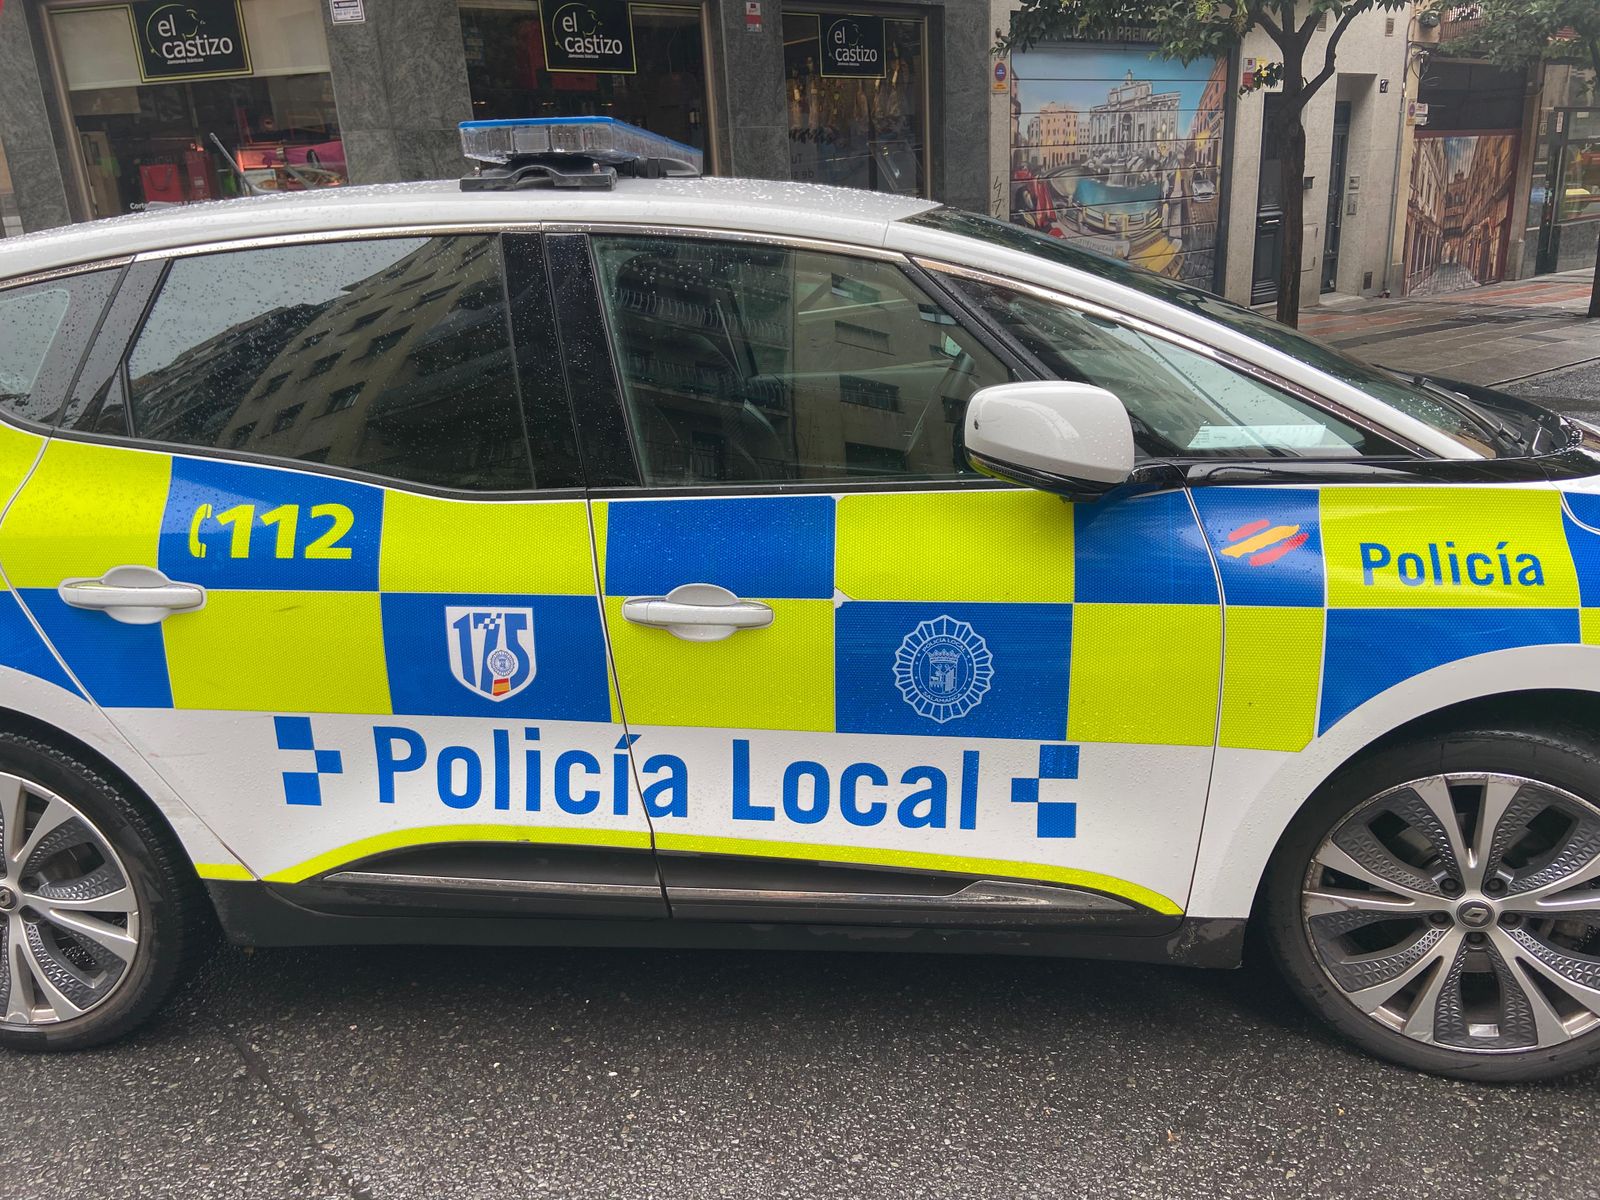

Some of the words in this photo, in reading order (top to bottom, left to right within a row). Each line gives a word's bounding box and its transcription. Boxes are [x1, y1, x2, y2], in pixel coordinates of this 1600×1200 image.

[157, 14, 177, 37] el
[562, 11, 578, 32] el
[162, 34, 234, 59] castizo
[564, 34, 623, 54] castizo
[834, 26, 846, 44] el
[835, 45, 878, 62] castizo
[216, 503, 354, 559] 112
[1359, 541, 1545, 587] Policía
[453, 613, 530, 694] 175
[947, 638, 967, 653] LOCAL
[373, 725, 689, 818] Policía
[732, 739, 980, 831] Local
